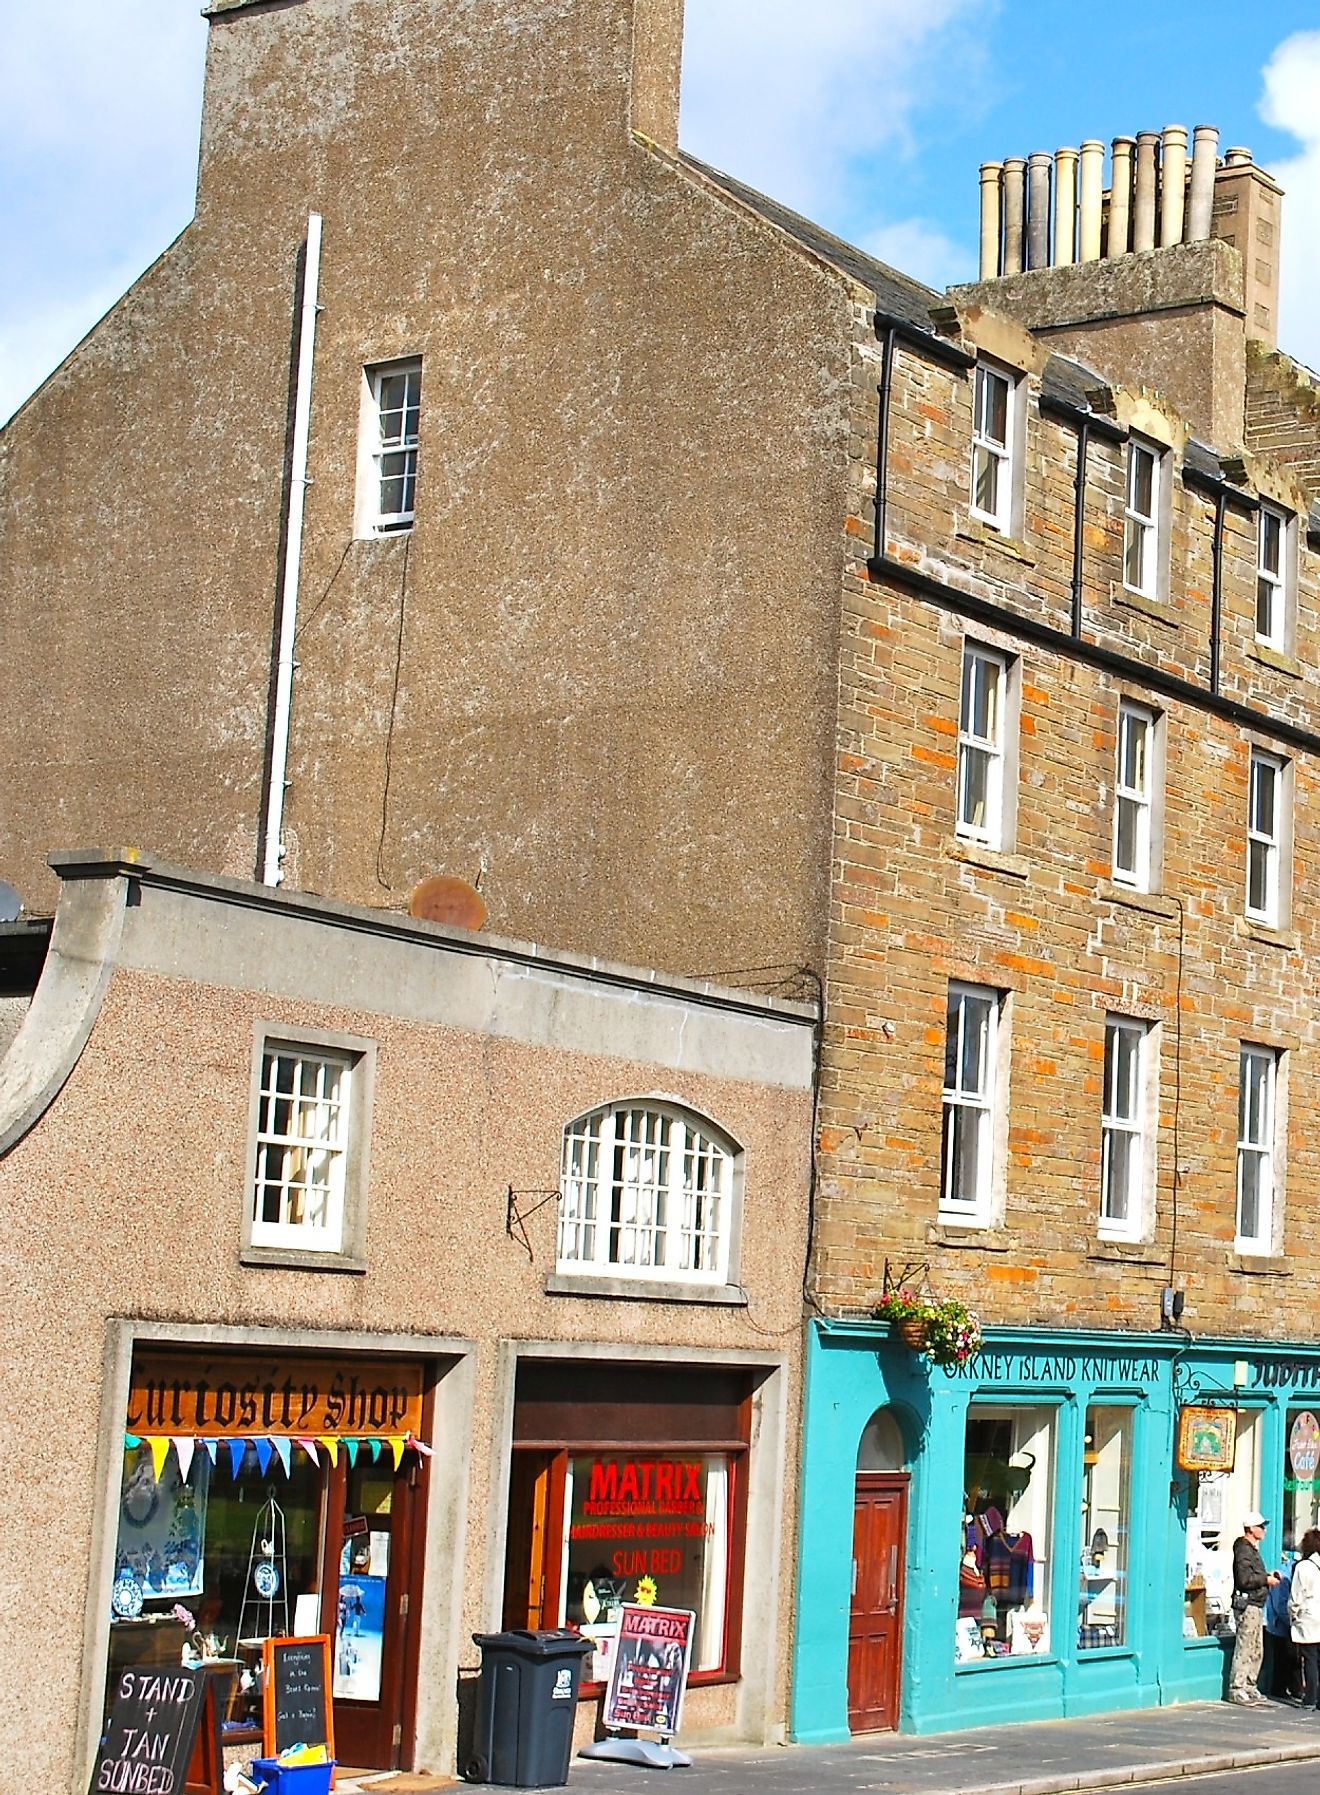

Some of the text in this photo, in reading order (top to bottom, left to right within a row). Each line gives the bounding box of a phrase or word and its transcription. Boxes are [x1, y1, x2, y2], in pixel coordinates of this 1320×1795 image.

[1081, 1357, 1160, 1383] KNITWEAR
[323, 1369, 409, 1429] Shop
[589, 1459, 703, 1500] MATRIX
[646, 1522, 683, 1538] BEAUTY
[613, 1548, 683, 1576] SUN BED
[623, 1614, 687, 1638] MATRIX
[120, 1672, 196, 1703] STAND
[614, 1708, 632, 1720] Sun
[121, 1728, 171, 1761] TAN
[98, 1759, 175, 1795] SUNBED
